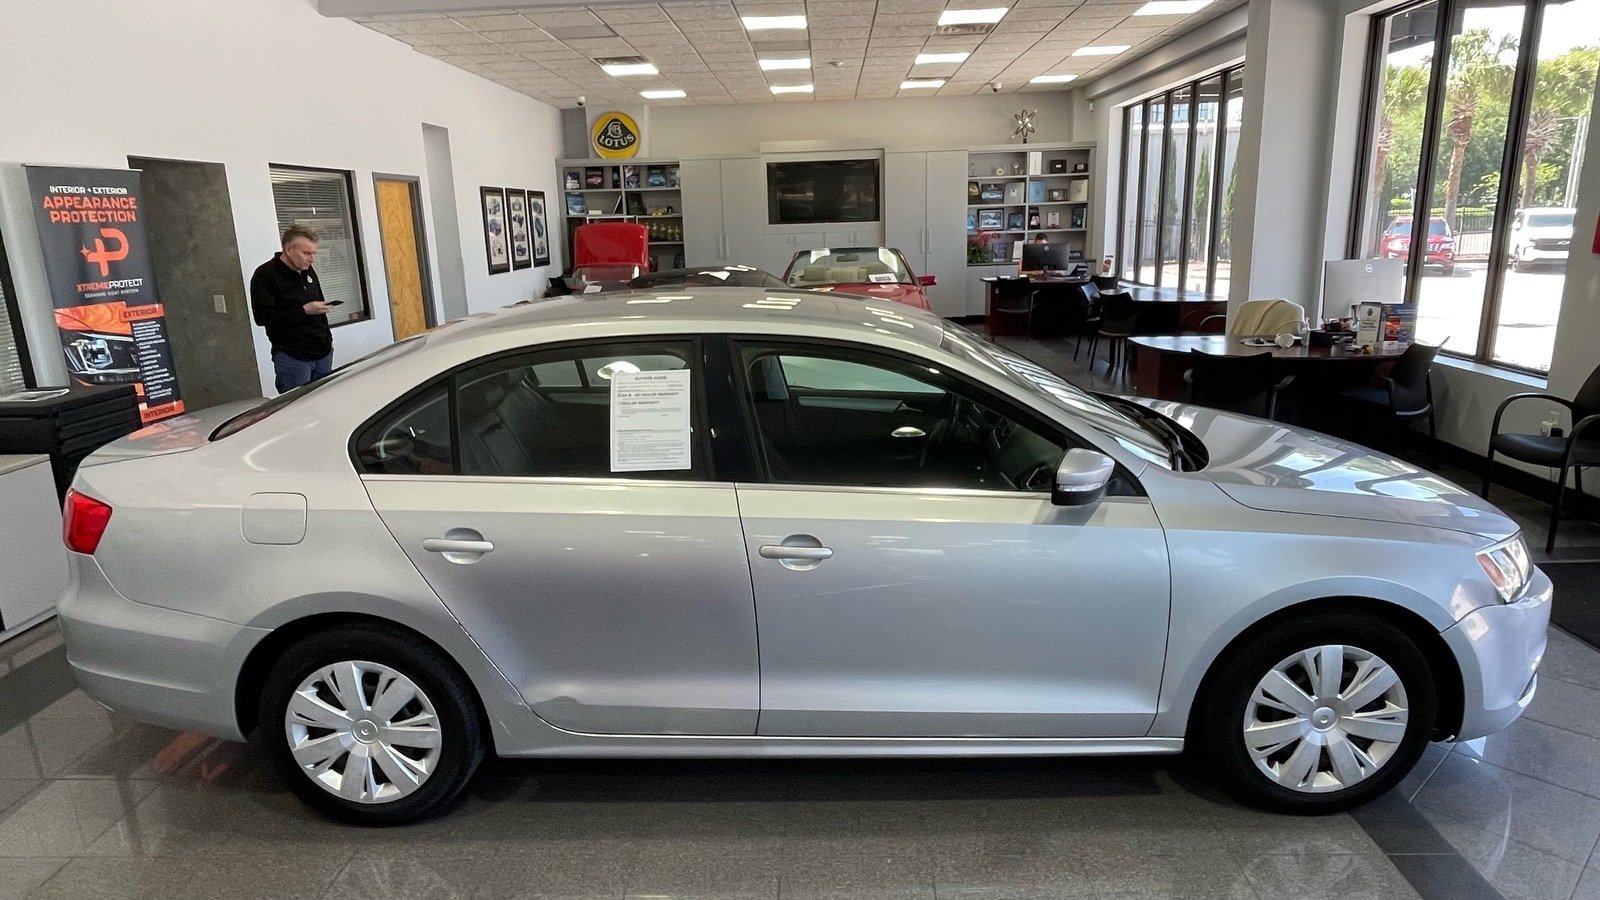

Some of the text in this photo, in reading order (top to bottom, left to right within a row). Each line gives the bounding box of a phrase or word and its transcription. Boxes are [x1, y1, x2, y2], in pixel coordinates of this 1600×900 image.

[600, 134, 634, 147] LOTUS
[49, 185, 86, 194] INTERIOR
[92, 186, 128, 195] EXTERIOR
[43, 196, 137, 209] APPEARANCE
[49, 210, 137, 223] PROTECTION
[123, 306, 158, 318] EXTERIOR
[143, 405, 176, 419] INTERIOR
